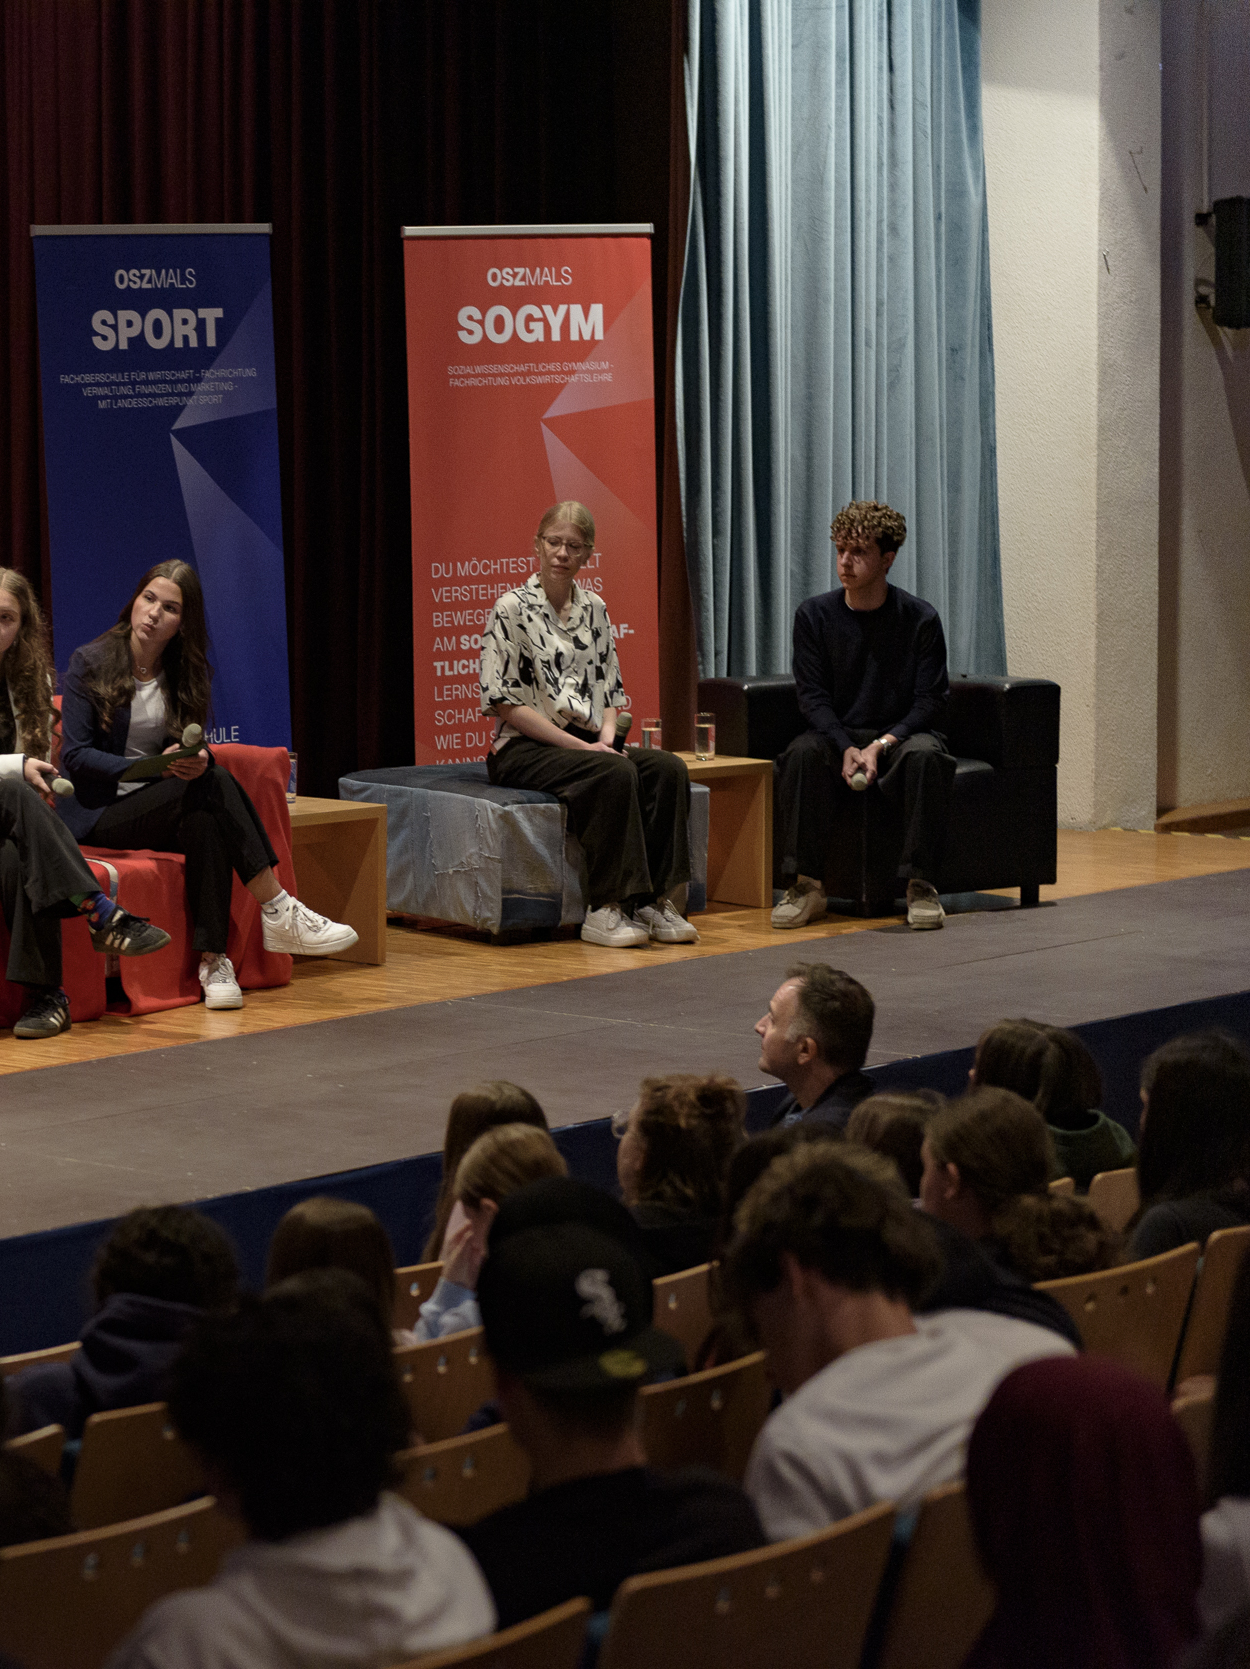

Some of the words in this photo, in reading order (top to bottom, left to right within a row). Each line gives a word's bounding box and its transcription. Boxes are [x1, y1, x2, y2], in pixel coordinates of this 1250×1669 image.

[114, 268, 197, 289] OSZMALS
[487, 266, 572, 287] OSZMALS
[91, 308, 224, 351] SPORT
[457, 303, 604, 345] SOGYM
[60, 371, 130, 384] FACHOBERSCHULE
[131, 370, 147, 381] FÜR
[147, 369, 194, 381] WIRTSCHAFT
[201, 368, 257, 379] FACHRICHTUNG
[447, 362, 561, 375] SOZIALWISSENSCHAFTLICHES
[562, 361, 609, 372] GYMNASIUM
[82, 385, 135, 396] VERWALTUNG,
[136, 383, 172, 394] FINANZEN
[173, 383, 190, 393] UND
[190, 381, 234, 393] MARKETING
[449, 376, 510, 387] FACHRICHTUNG
[511, 373, 613, 385] VOLKSWIRTSCHAFTSLEHRE
[98, 399, 111, 409] MIT
[112, 396, 199, 409] LANDESSCHWERPUNKT
[200, 394, 223, 405] SPORT
[431, 562, 453, 578] DU
[456, 556, 535, 577] MÖCHTEST
[432, 608, 493, 627] BEWEGE
[433, 635, 457, 652] AM
[459, 633, 482, 650] SO
[433, 657, 480, 676] TLICH
[434, 683, 481, 701] LERNS
[434, 733, 462, 750] WIE
[465, 731, 486, 747] DU
